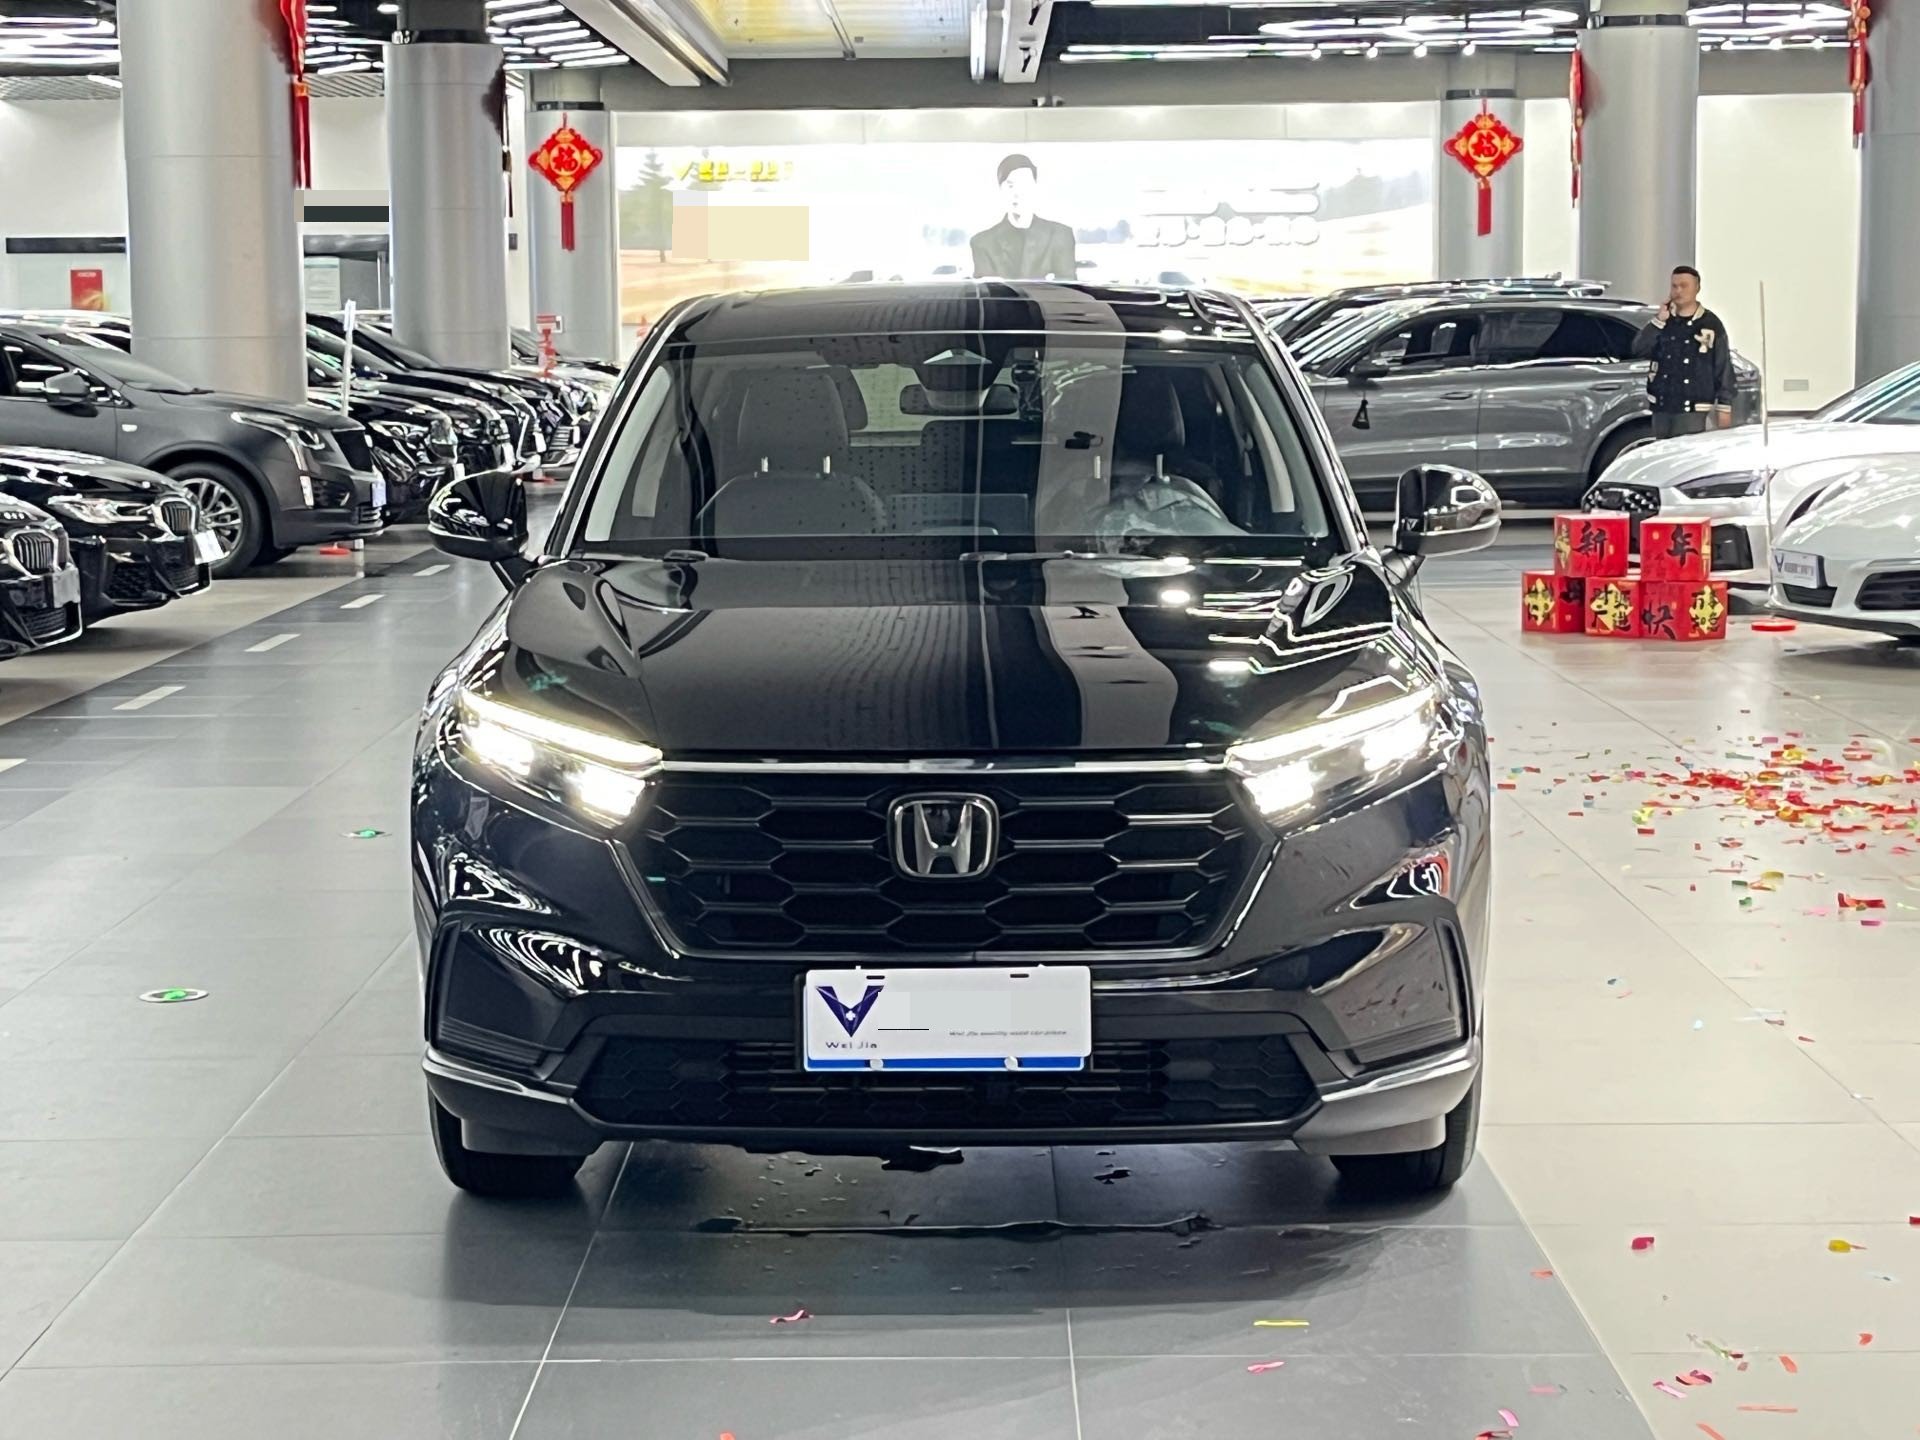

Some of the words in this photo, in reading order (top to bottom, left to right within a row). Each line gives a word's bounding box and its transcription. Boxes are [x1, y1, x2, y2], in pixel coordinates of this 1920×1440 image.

[552, 145, 578, 172] 福
[1470, 130, 1500, 159] 福
[1571, 521, 1608, 562] 新
[1666, 524, 1699, 568] 年
[1641, 601, 1677, 640] 快
[825, 1041, 853, 1050] Wei
